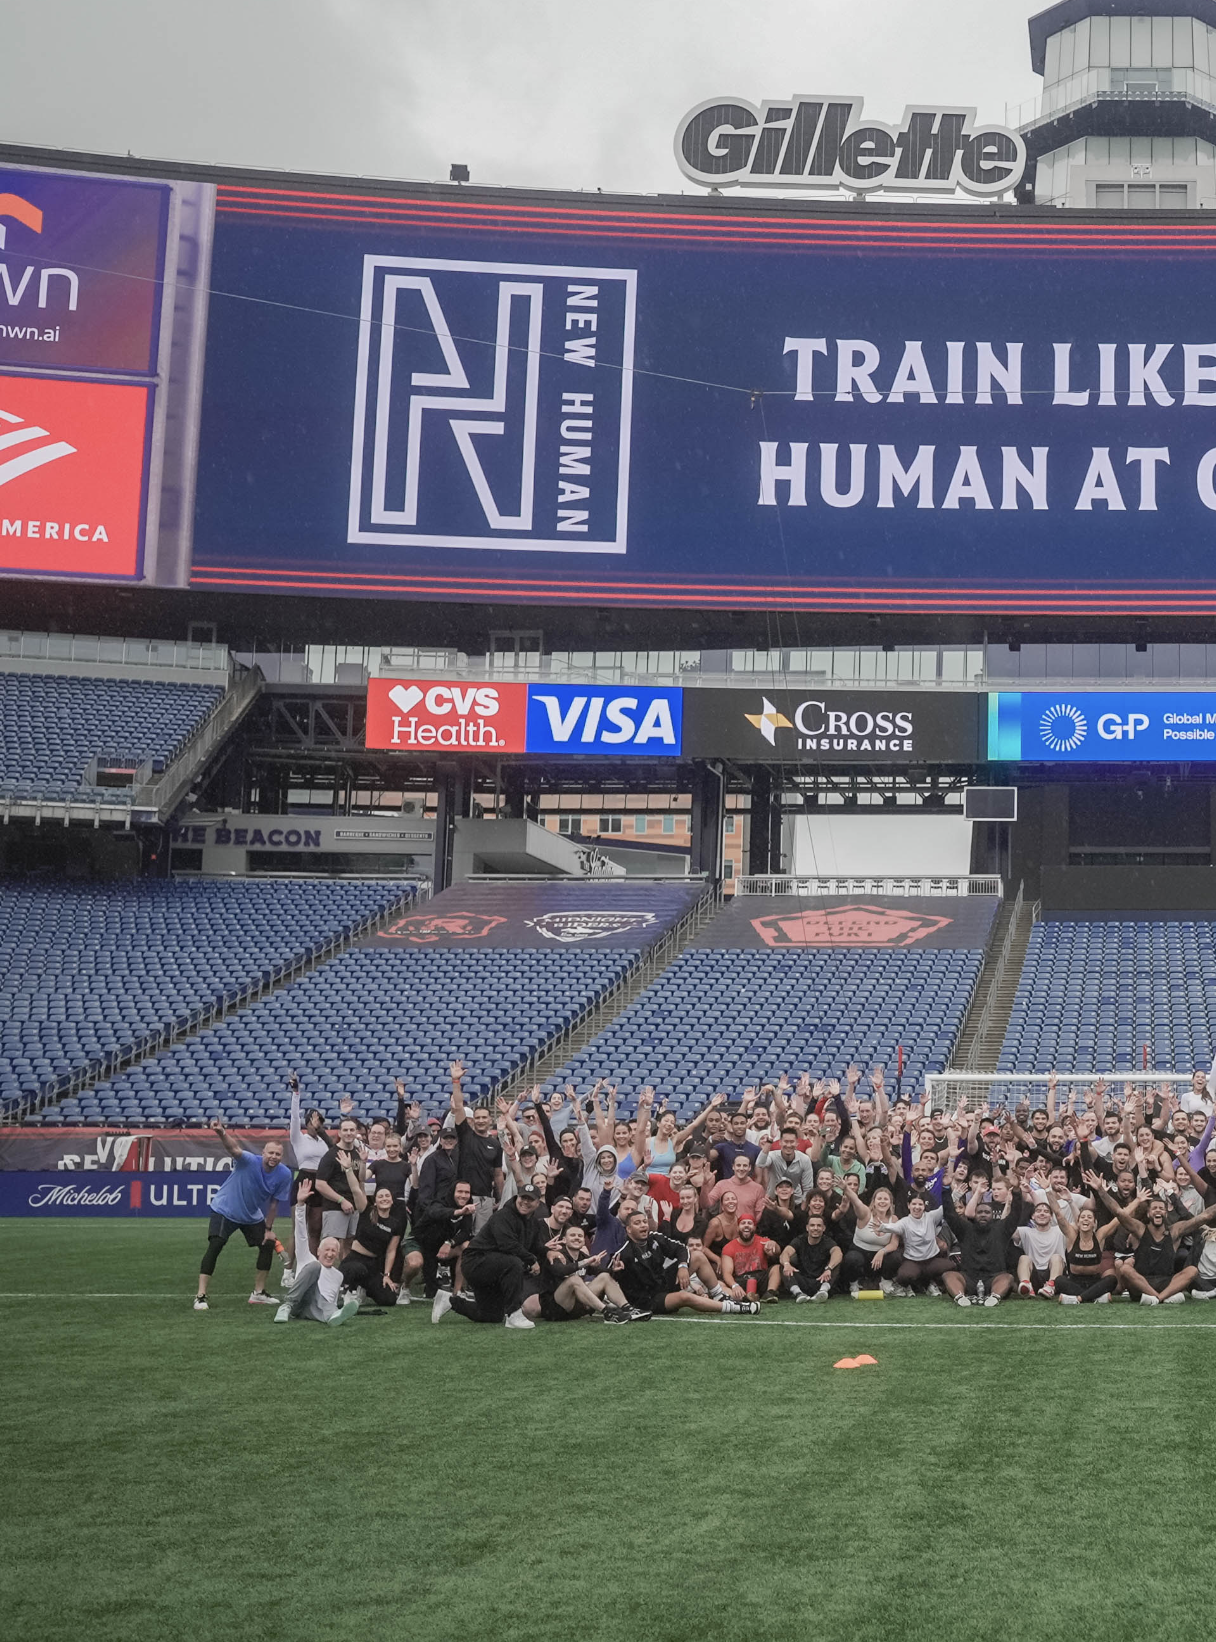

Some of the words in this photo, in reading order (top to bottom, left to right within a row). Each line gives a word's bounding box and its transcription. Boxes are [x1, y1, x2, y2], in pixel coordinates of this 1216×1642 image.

[680, 100, 1019, 186] Gillette
[563, 284, 599, 368] NEW
[783, 337, 1023, 404] TRAIN
[556, 392, 594, 532] HUMAN
[757, 442, 1048, 509] HUMAN
[1075, 447, 1170, 510] AT
[425, 686, 500, 717] CVS
[533, 696, 676, 744] VISA
[1163, 713, 1203, 724] Global
[797, 738, 913, 752] INSURANCE
[1163, 729, 1215, 740] Possible
[214, 827, 321, 847] BEACON
[28, 1184, 126, 1208] Michelob
